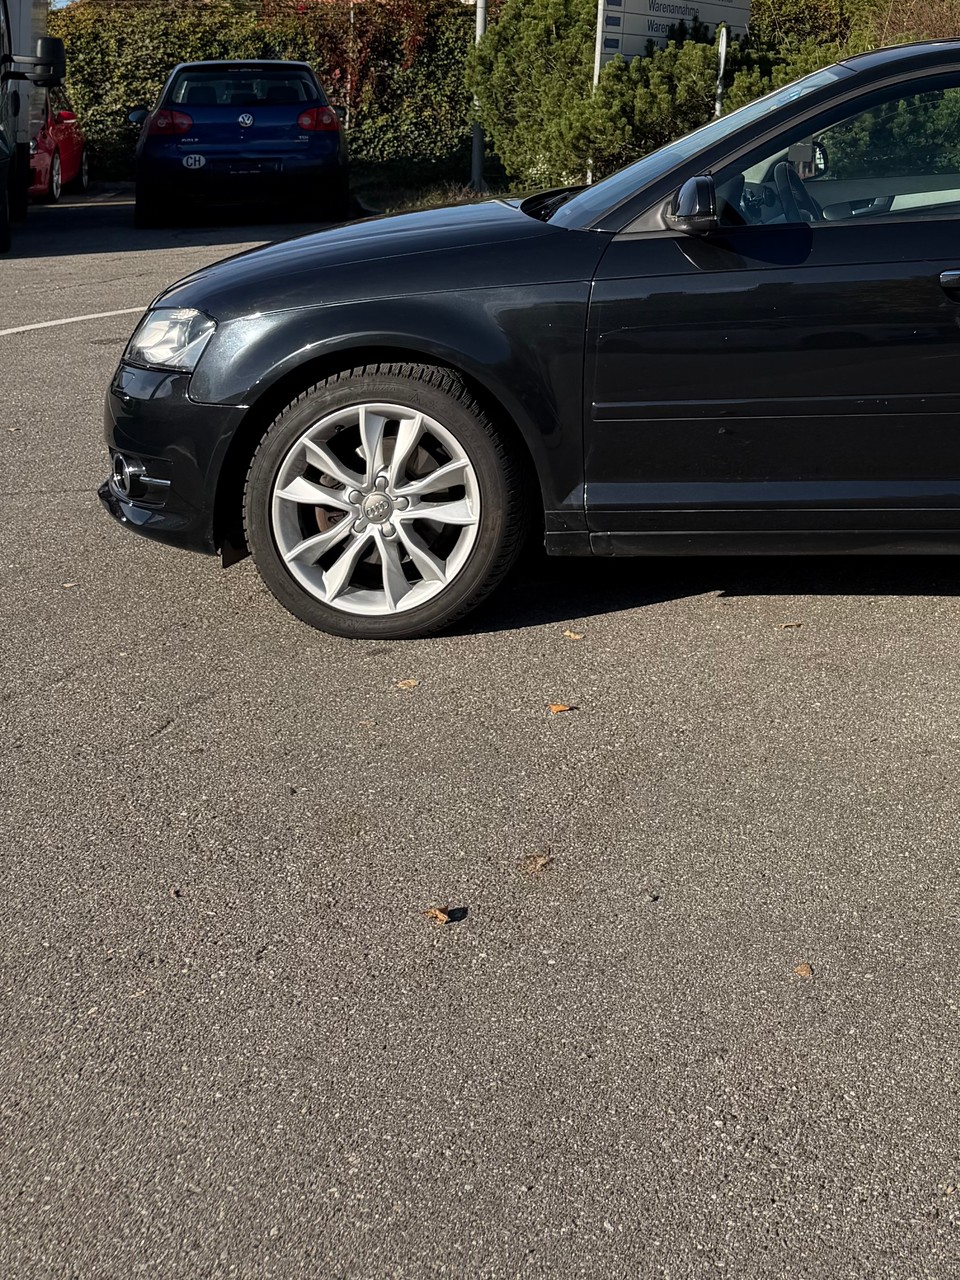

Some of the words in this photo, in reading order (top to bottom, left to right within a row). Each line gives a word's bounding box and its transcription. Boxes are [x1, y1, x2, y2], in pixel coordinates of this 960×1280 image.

[648, 0, 699, 17] Warenannahme
[647, 19, 669, 33] Waren
[186, 156, 201, 167] CH
